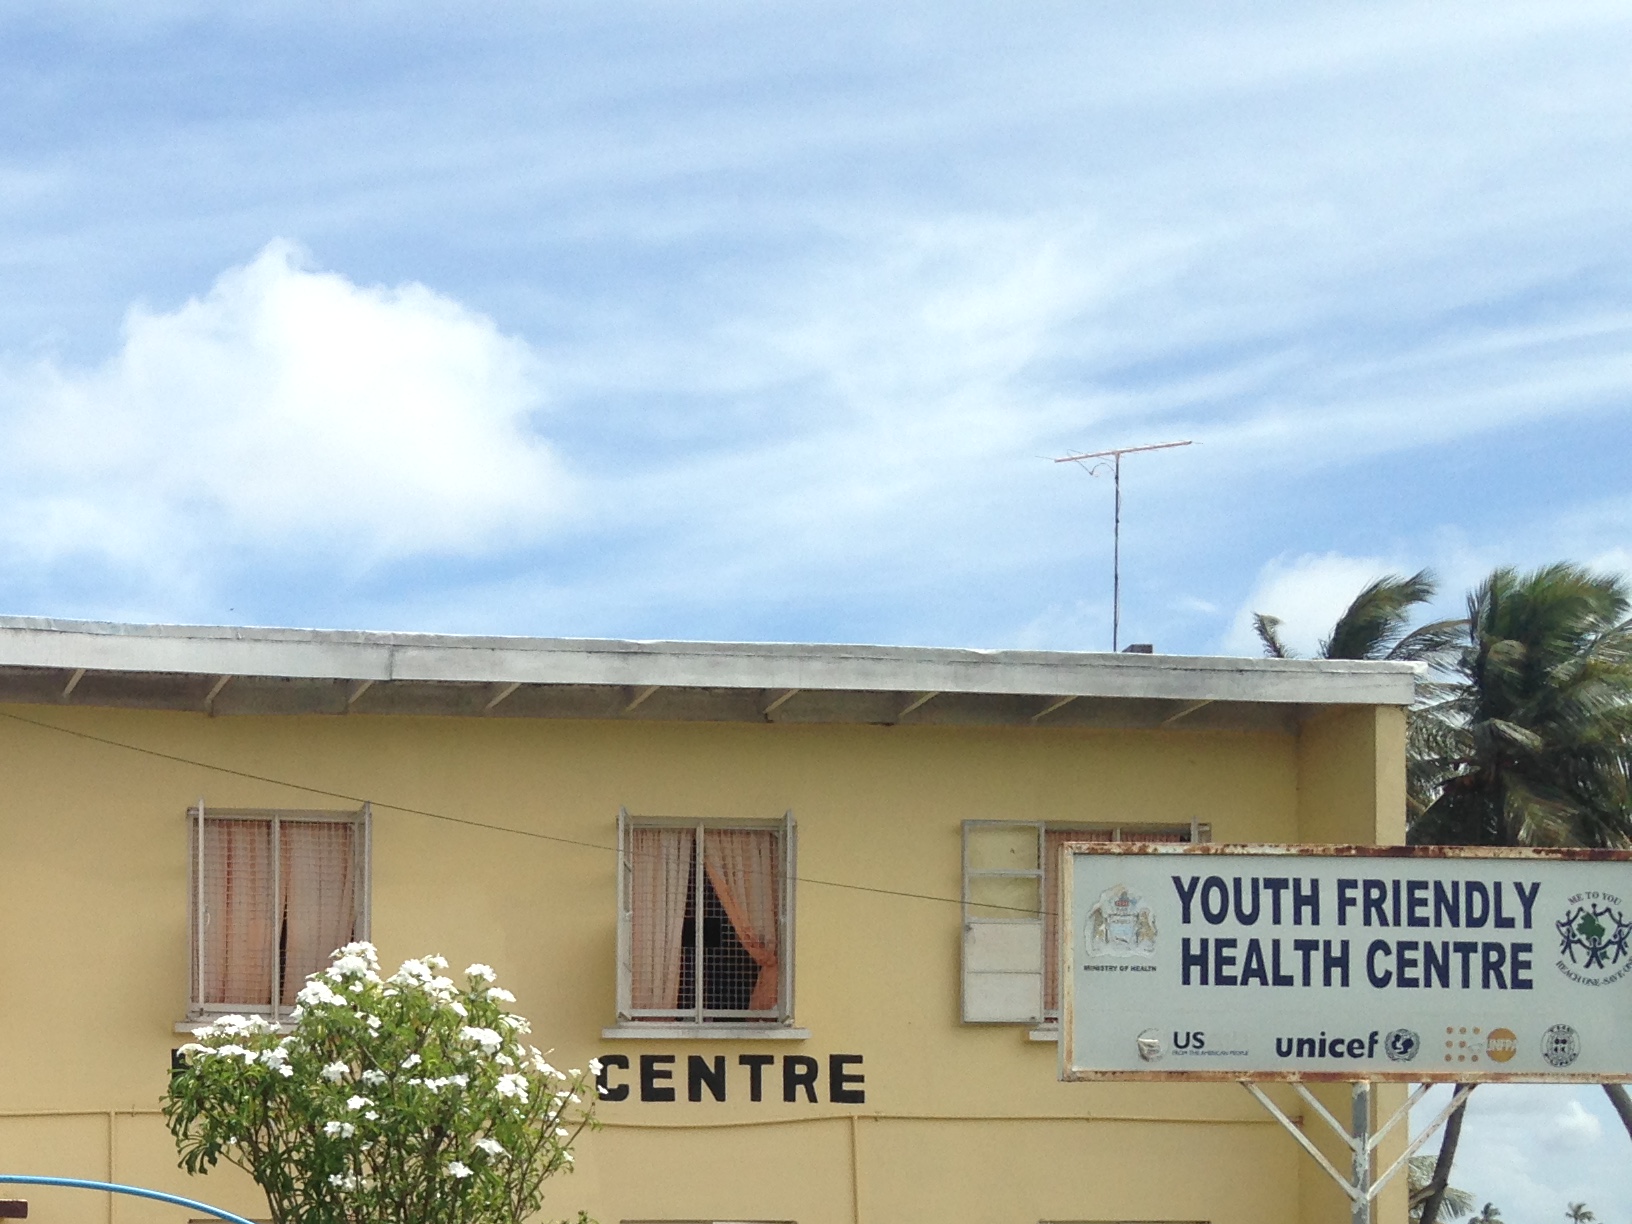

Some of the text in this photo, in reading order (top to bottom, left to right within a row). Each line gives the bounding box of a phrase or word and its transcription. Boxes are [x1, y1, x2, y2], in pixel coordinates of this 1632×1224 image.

[1172, 875, 1542, 930] YOUTH FRIENDLY
[1568, 891, 1622, 905] ME TO YOU
[1181, 937, 1534, 990] HEALTH CENTRE
[1275, 1030, 1379, 1059] unicef
[595, 1053, 866, 1105] CENTRE
